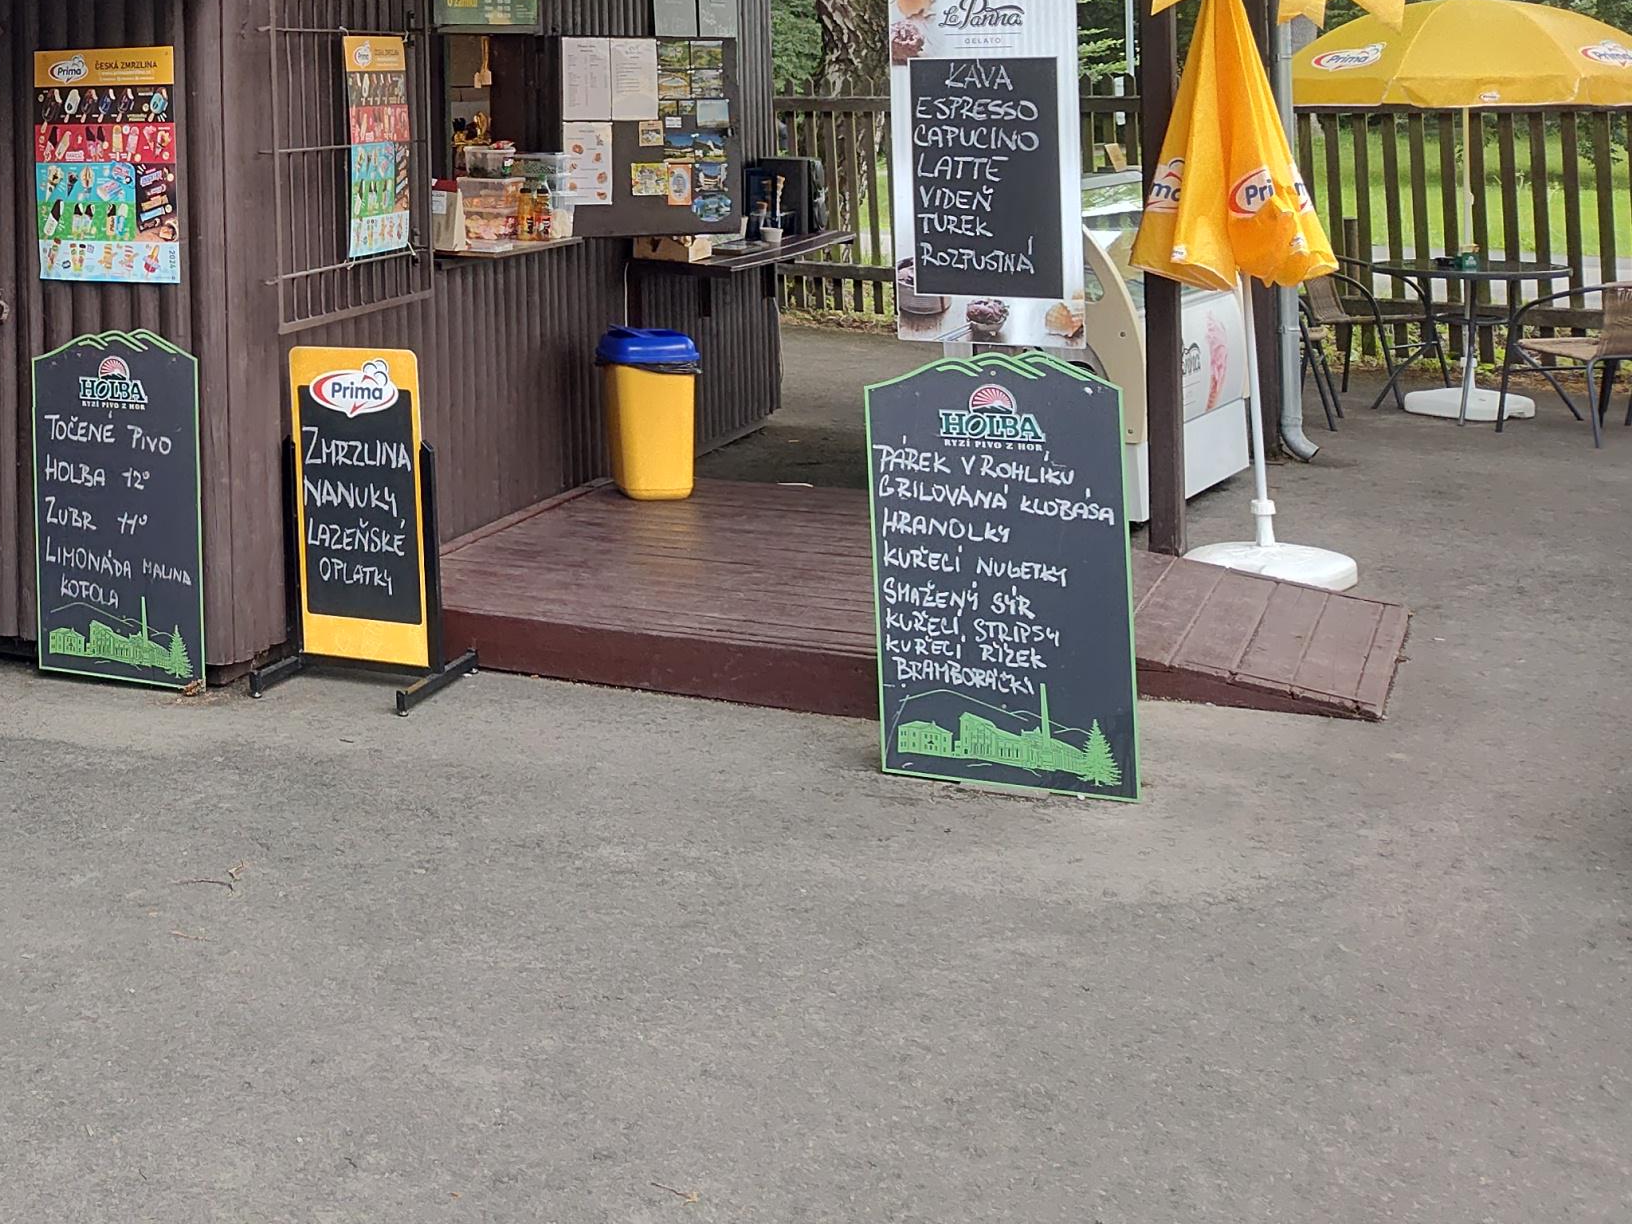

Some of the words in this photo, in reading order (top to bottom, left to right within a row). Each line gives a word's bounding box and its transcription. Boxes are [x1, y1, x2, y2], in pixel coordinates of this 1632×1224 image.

[938, 5, 961, 27] La
[964, 37, 1001, 45] GELATO
[57, 67, 82, 77] Prima
[1326, 54, 1369, 64] Prima
[916, 96, 1039, 121] ESPRESSO
[913, 124, 1039, 152] CAPUCINO
[917, 153, 1009, 182] LATTE
[919, 185, 994, 212] VIDEŇ
[1245, 179, 1275, 206] Pri
[917, 212, 994, 237] TUREK
[920, 236, 1035, 274] ROZPUSTNÁ
[79, 377, 147, 403] HOLBA
[331, 381, 383, 400] Prima
[44, 411, 116, 443] TOČENÉ
[127, 425, 172, 454] PIVO
[939, 409, 1046, 442] HOLBA
[302, 426, 411, 472] ZMRZLINA
[872, 435, 951, 474] PÁREK
[961, 455, 976, 475] V
[980, 450, 1075, 486] ROHLÍKU
[944, 438, 970, 447] RYZÍ
[975, 440, 1002, 449] PIVO
[1006, 442, 1013, 450] Z
[1018, 442, 1043, 451] HOR
[45, 453, 105, 487] HOLBA
[304, 475, 398, 517] NANUKY
[879, 474, 1008, 509] GRILOVANÁ
[1020, 488, 1115, 526] KLOBÁSA
[45, 496, 97, 530] ZUBR
[882, 507, 1010, 543] HRANOLKY
[46, 536, 131, 579] LIMONÁDA
[883, 540, 963, 573] KUŘECÍ
[61, 572, 119, 609] KOFOLA
[319, 557, 393, 596] OPLATKY
[882, 577, 979, 610] SMAŽENÝ
[990, 585, 1036, 619] SÝR
[885, 607, 963, 636] KUŘECÍ
[973, 618, 1060, 647] STRIPSY
[885, 634, 966, 660] KUŘECÍ
